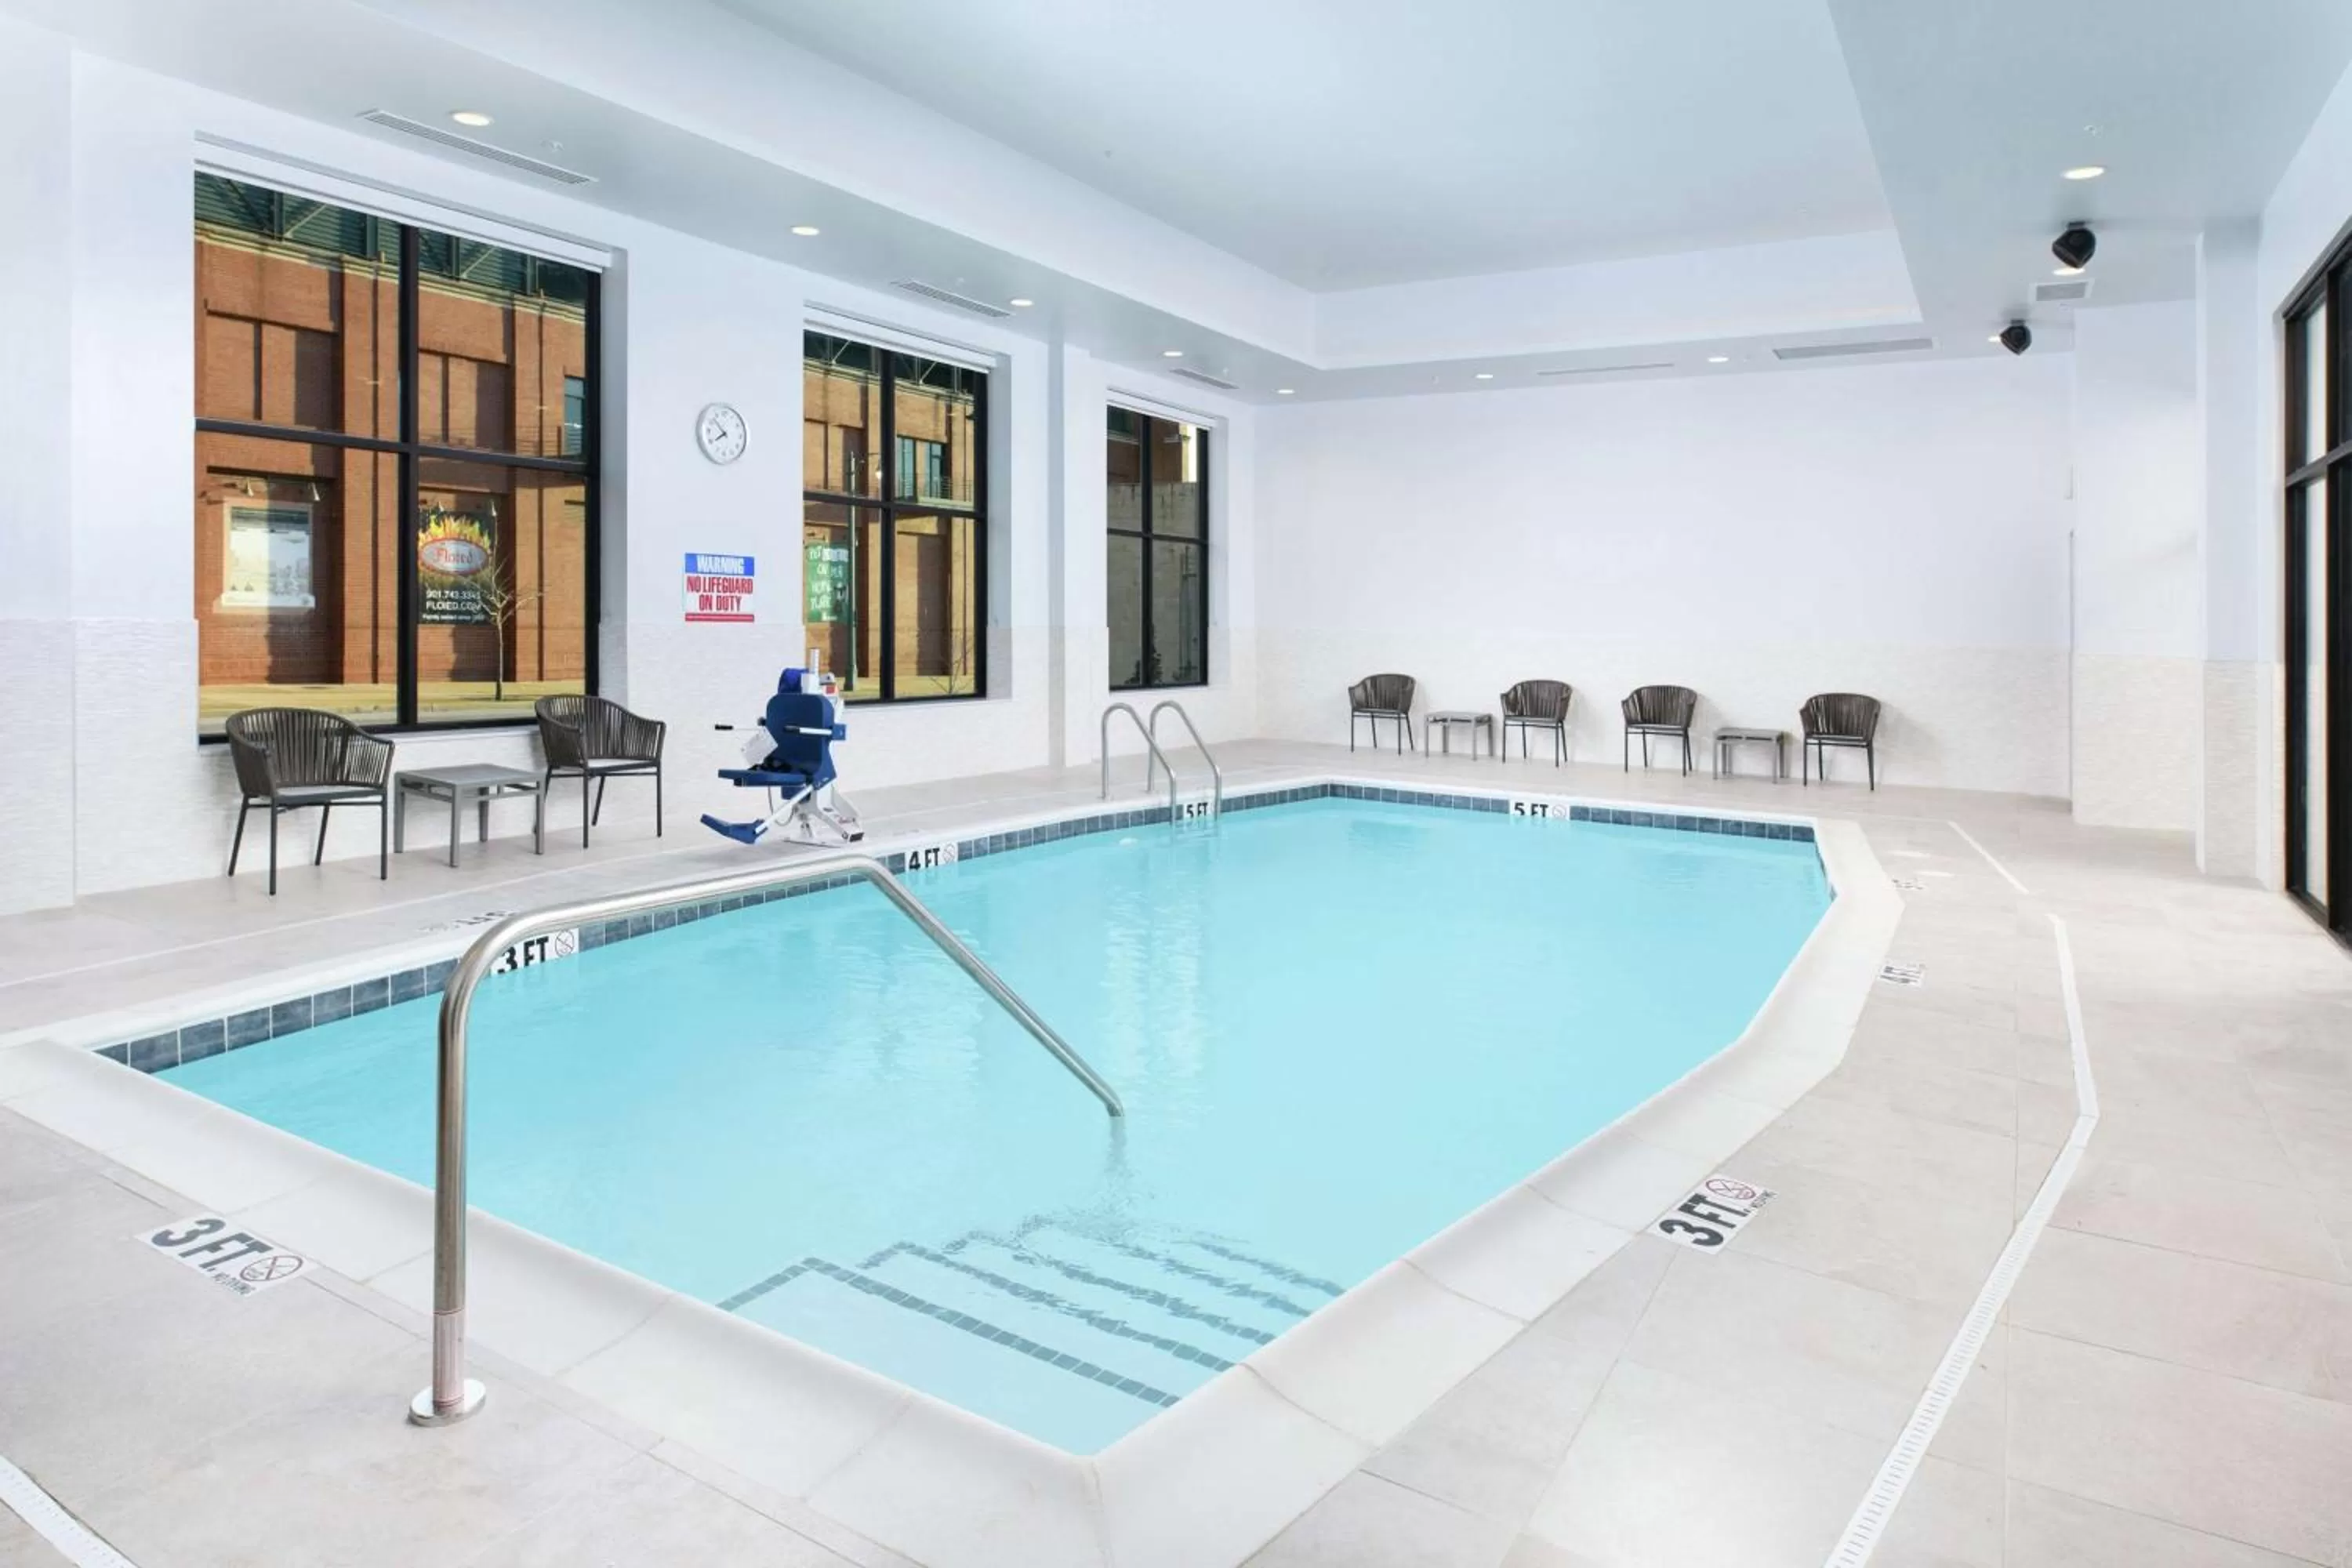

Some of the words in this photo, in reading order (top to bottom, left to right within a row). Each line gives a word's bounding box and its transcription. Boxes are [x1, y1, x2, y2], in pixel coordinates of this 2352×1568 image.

[697, 555, 744, 575] WARNING
[687, 575, 701, 593] NO
[702, 576, 753, 594] LIFEGUARD
[699, 594, 712, 611] ON
[717, 595, 742, 612] DUTY
[1186, 804, 1194, 818] 5
[1197, 802, 1207, 816] FT
[1514, 802, 1525, 816] 5
[1530, 803, 1548, 817] FT
[909, 851, 921, 870] 4
[924, 848, 940, 868] FT
[497, 946, 518, 974] 3
[523, 935, 549, 967] FT
[151, 1218, 227, 1247] 3
[1659, 1219, 1724, 1247] 3
